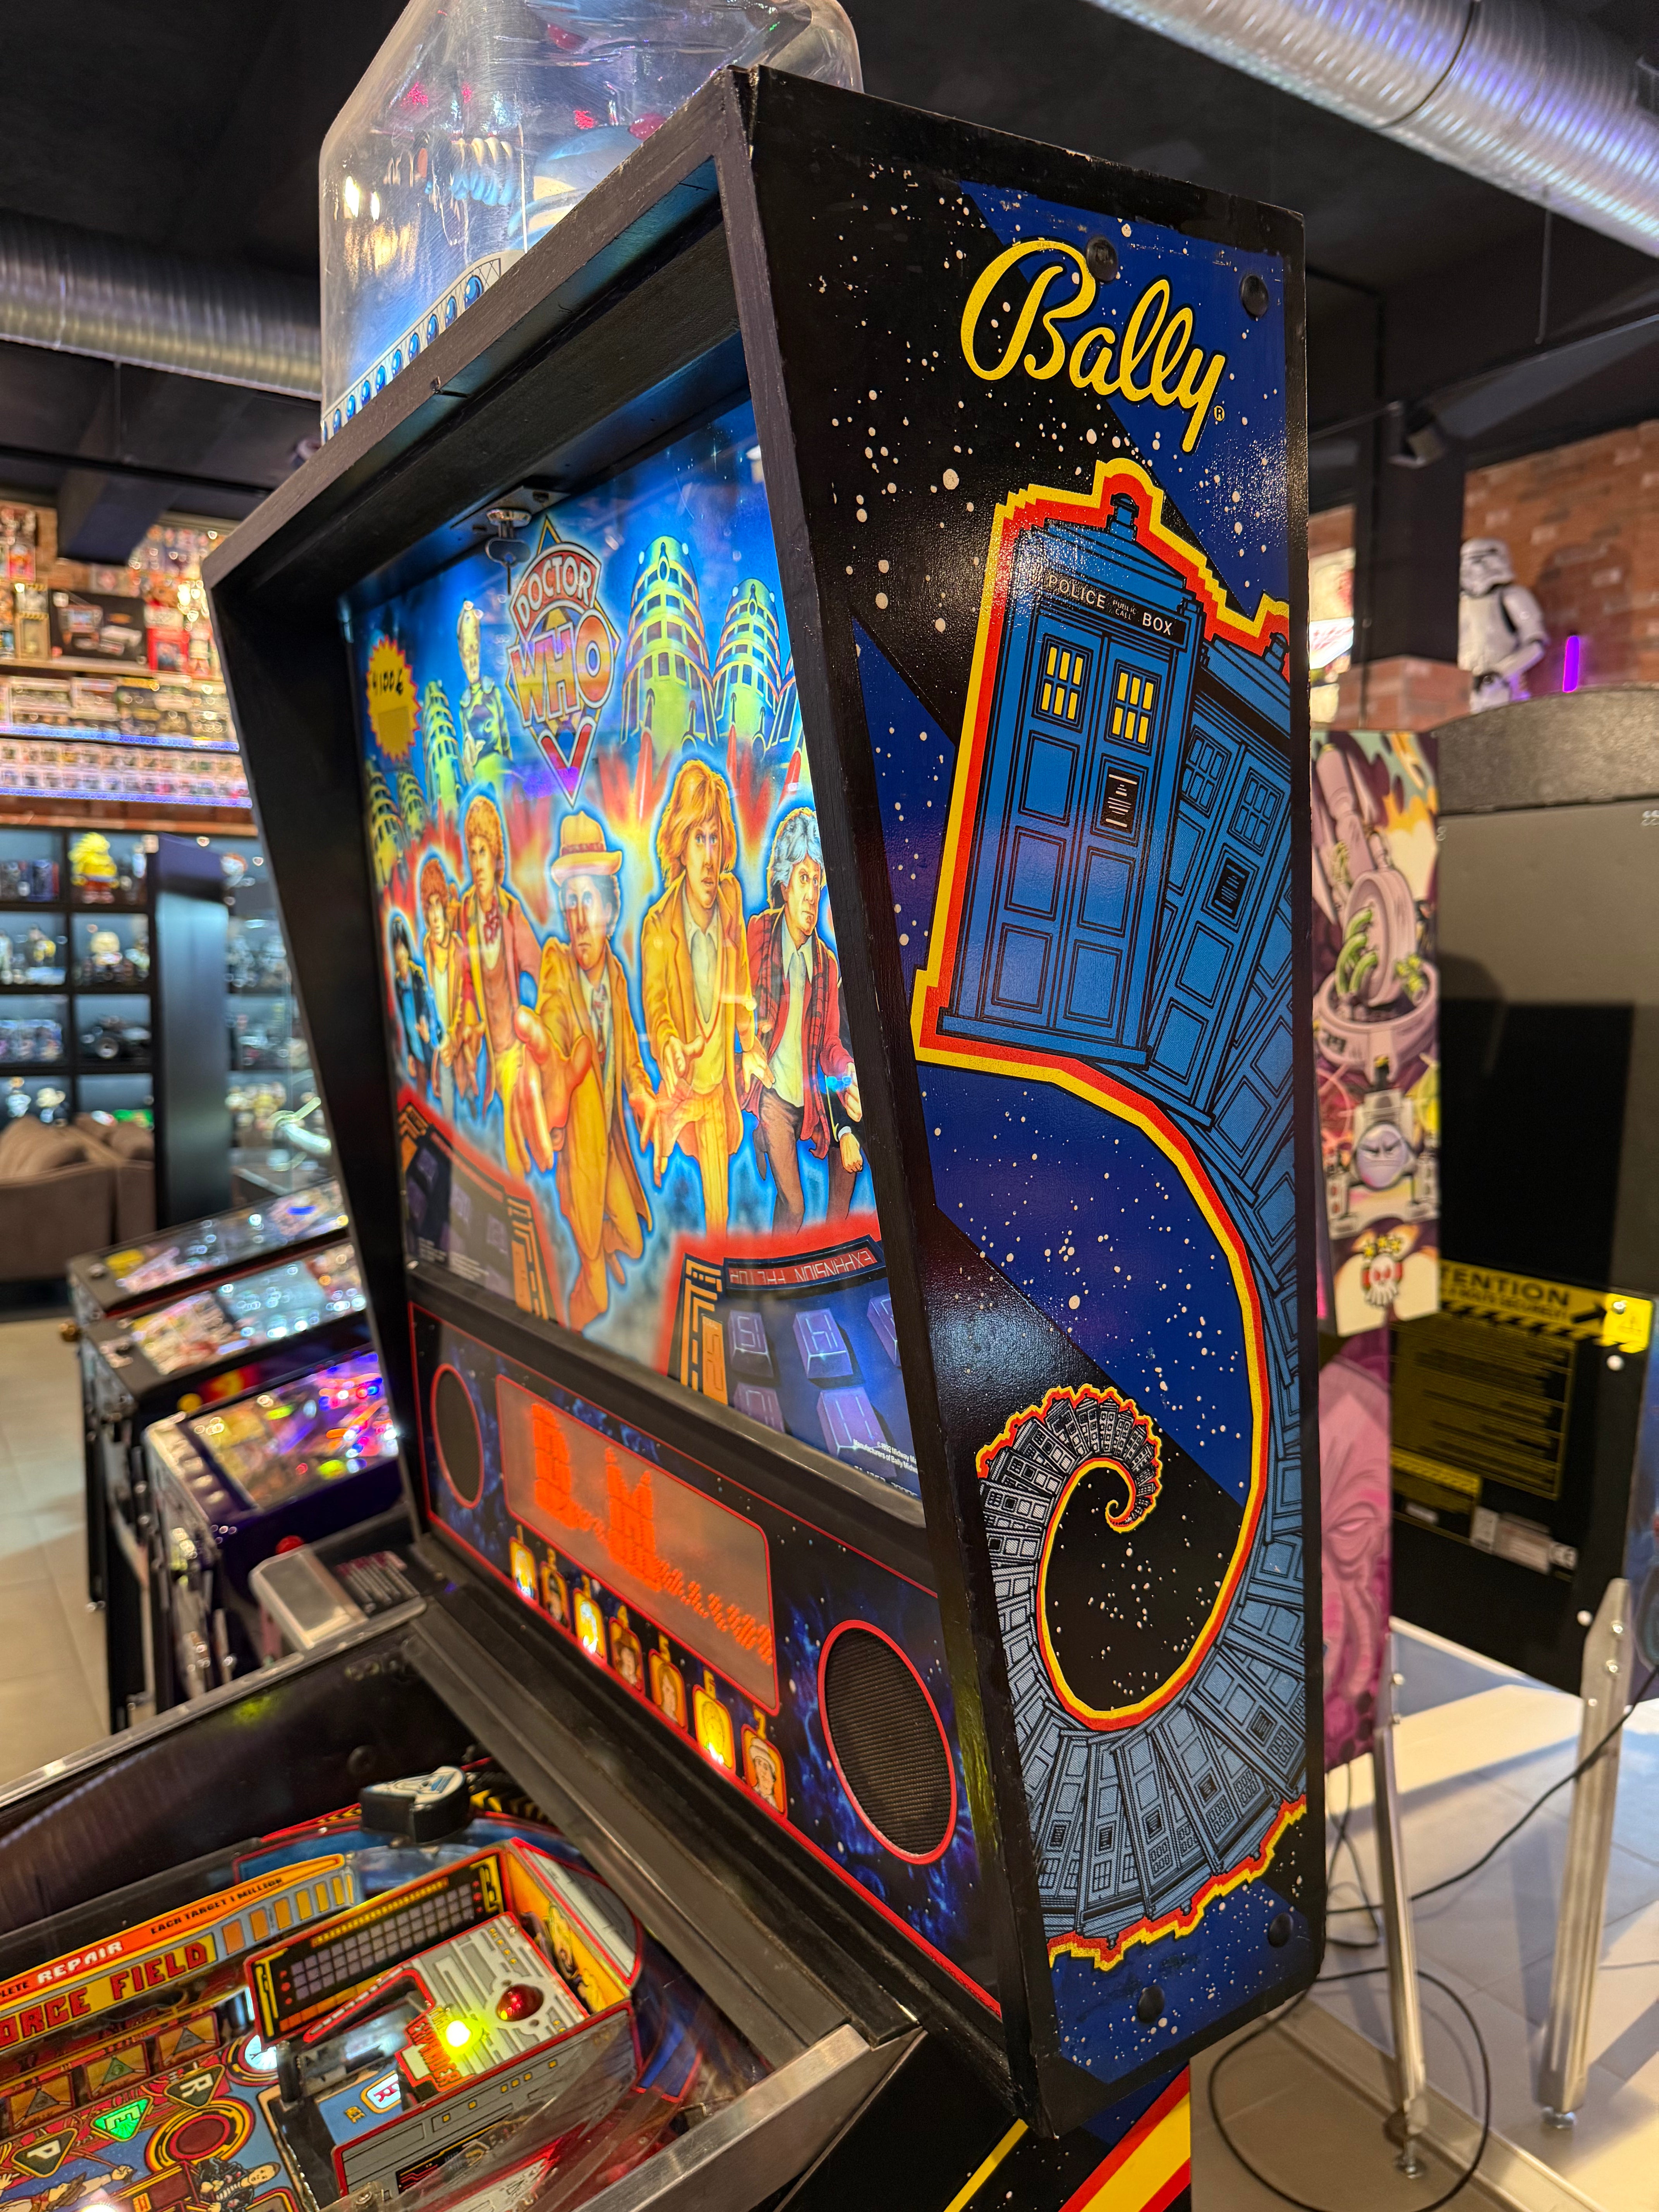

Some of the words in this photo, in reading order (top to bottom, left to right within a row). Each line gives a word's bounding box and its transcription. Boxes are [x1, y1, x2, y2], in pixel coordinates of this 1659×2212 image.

[961, 240, 1225, 452] Bally
[515, 555, 592, 629] DOCTOR
[1048, 575, 1106, 609] POLICE
[1142, 612, 1173, 635] BOX
[1113, 600, 1137, 615] PUBLIC
[1115, 608, 1131, 620] CALL
[507, 610, 615, 726] WHO
[853, 1439, 885, 1459] Manufacturers
[892, 1447, 909, 1462] Midway
[753, 1705, 767, 1740] 7
[184, 1899, 227, 1922] TARGET
[237, 1878, 283, 1899] MILLION
[38, 1941, 124, 1984] REPAIR
[110, 1941, 208, 2001] FIELD
[408, 2018, 462, 2087] EXPANDER
